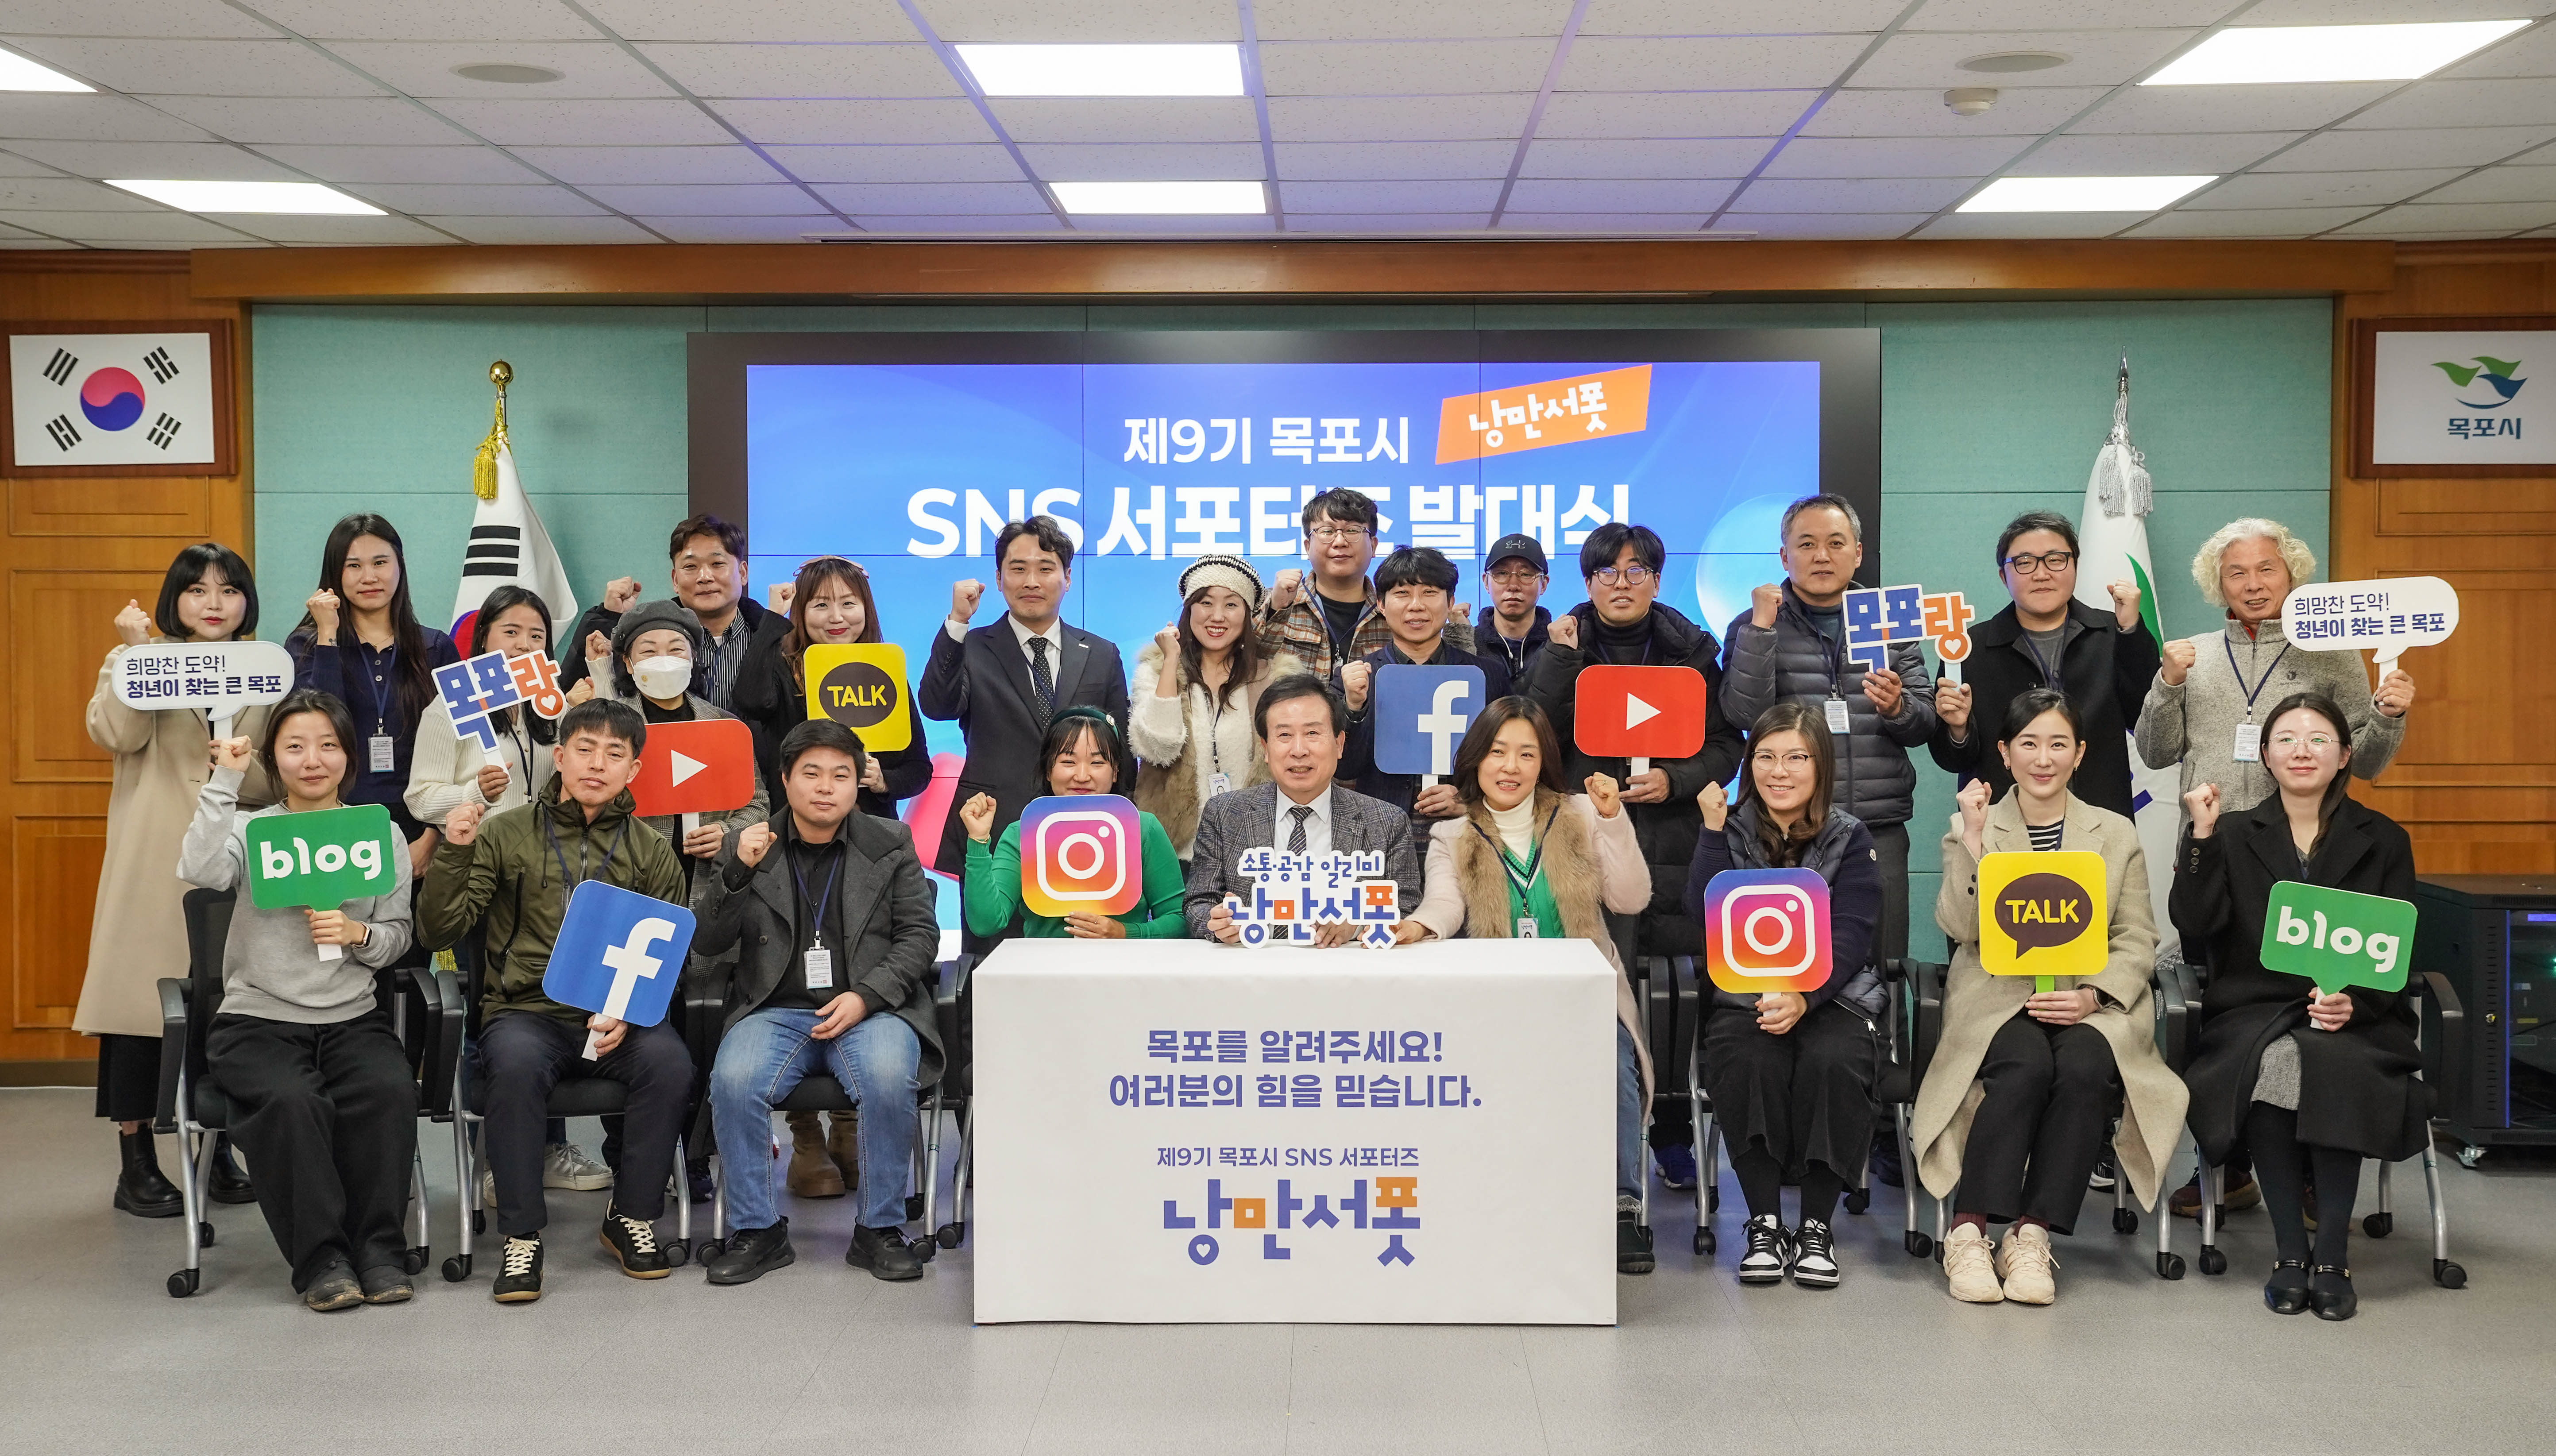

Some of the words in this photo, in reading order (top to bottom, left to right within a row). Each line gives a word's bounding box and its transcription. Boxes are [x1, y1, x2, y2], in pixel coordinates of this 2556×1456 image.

[1469, 382, 1607, 447] 낭만서폿
[2447, 417, 2521, 439] 목포시
[1124, 417, 1251, 464] 제9기
[1270, 417, 1409, 464] 목포시
[907, 488, 1084, 558] SNS
[2295, 595, 2344, 616] 희망찬
[2351, 593, 2389, 613] 도약!
[1846, 587, 1971, 674] 목포랑
[2295, 618, 2344, 639] 청년이
[2351, 617, 2383, 636] 찾는
[2390, 615, 2405, 634] 큰
[2412, 613, 2445, 633] 목포
[126, 657, 179, 676] 희망찬
[185, 655, 225, 672] 도약!
[127, 679, 179, 699] 청년이
[185, 678, 219, 696] 찾는
[226, 676, 242, 694] 큰
[248, 676, 281, 693] 목포
[436, 653, 563, 749] 목포랑
[827, 685, 887, 707] TALK
[1417, 680, 1469, 774] f
[260, 837, 382, 881] blog
[1321, 856, 1379, 888] 알리미
[1228, 886, 1395, 944] 낭만서폿
[2005, 899, 2079, 923] TALK
[2276, 905, 2400, 973] blog
[602, 917, 676, 1020] f
[1147, 1030, 1248, 1063] 목포를
[1260, 1030, 1443, 1064] 알려주세요!
[1110, 1074, 1243, 1108] 여러분의
[1256, 1074, 1323, 1108] 힘을
[1335, 1074, 1482, 1108] 믿습니다.
[1157, 1147, 1211, 1167] 제9기
[1219, 1147, 1278, 1167] 목포시
[1285, 1147, 1332, 1166] SNS
[1340, 1147, 1419, 1167] 서포터즈
[1164, 1177, 1420, 1267] 낭만서폿
